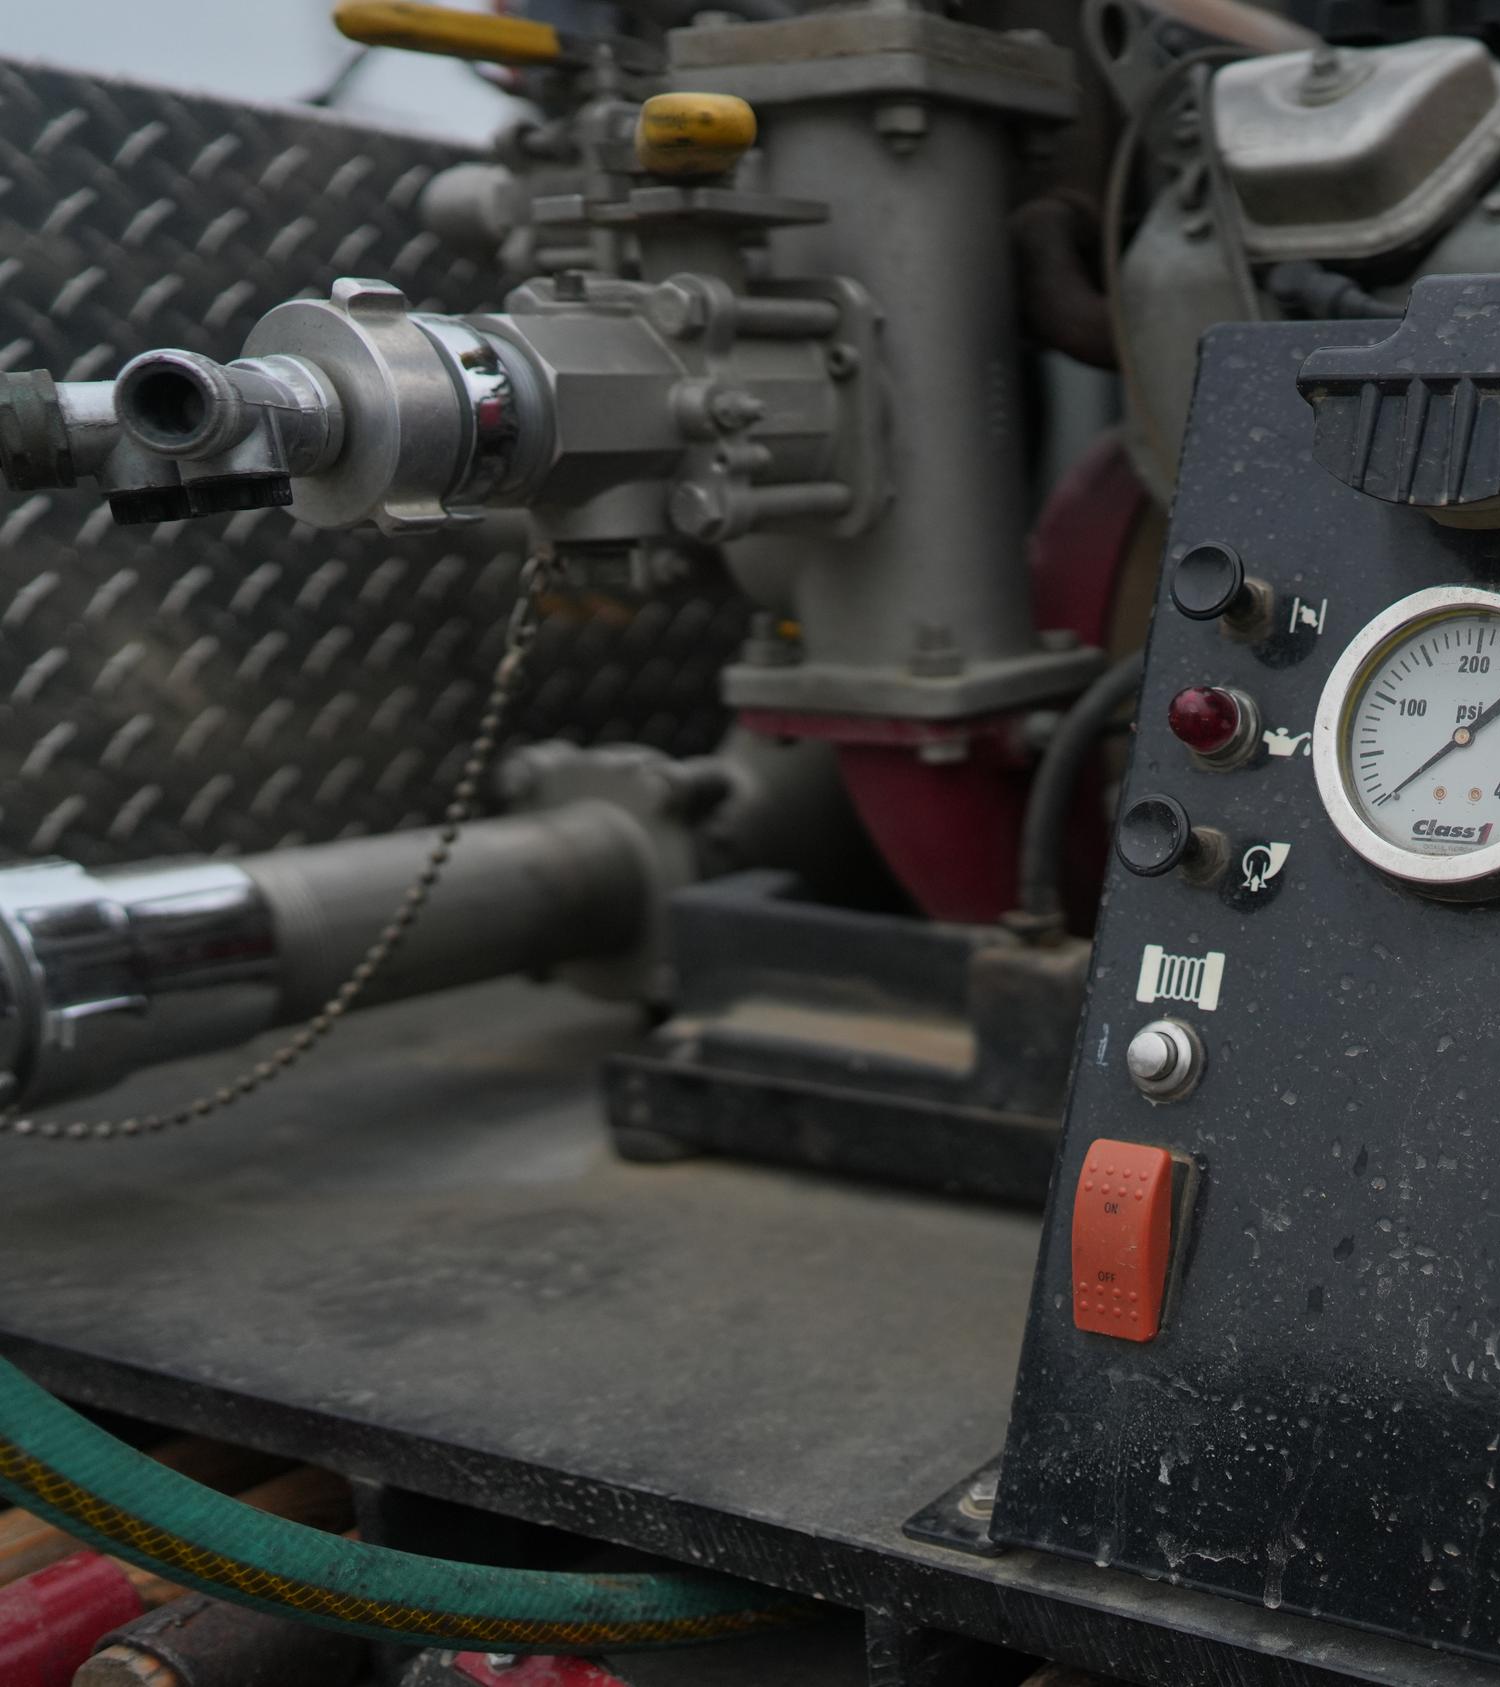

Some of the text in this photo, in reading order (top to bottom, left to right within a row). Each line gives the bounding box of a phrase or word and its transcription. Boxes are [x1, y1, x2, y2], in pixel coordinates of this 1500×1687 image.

[1458, 655, 1490, 674] 200
[1399, 699, 1427, 717] 100
[1455, 702, 1484, 723] psi
[1104, 1202, 1119, 1214] ON
[1097, 1271, 1117, 1283] OFF
